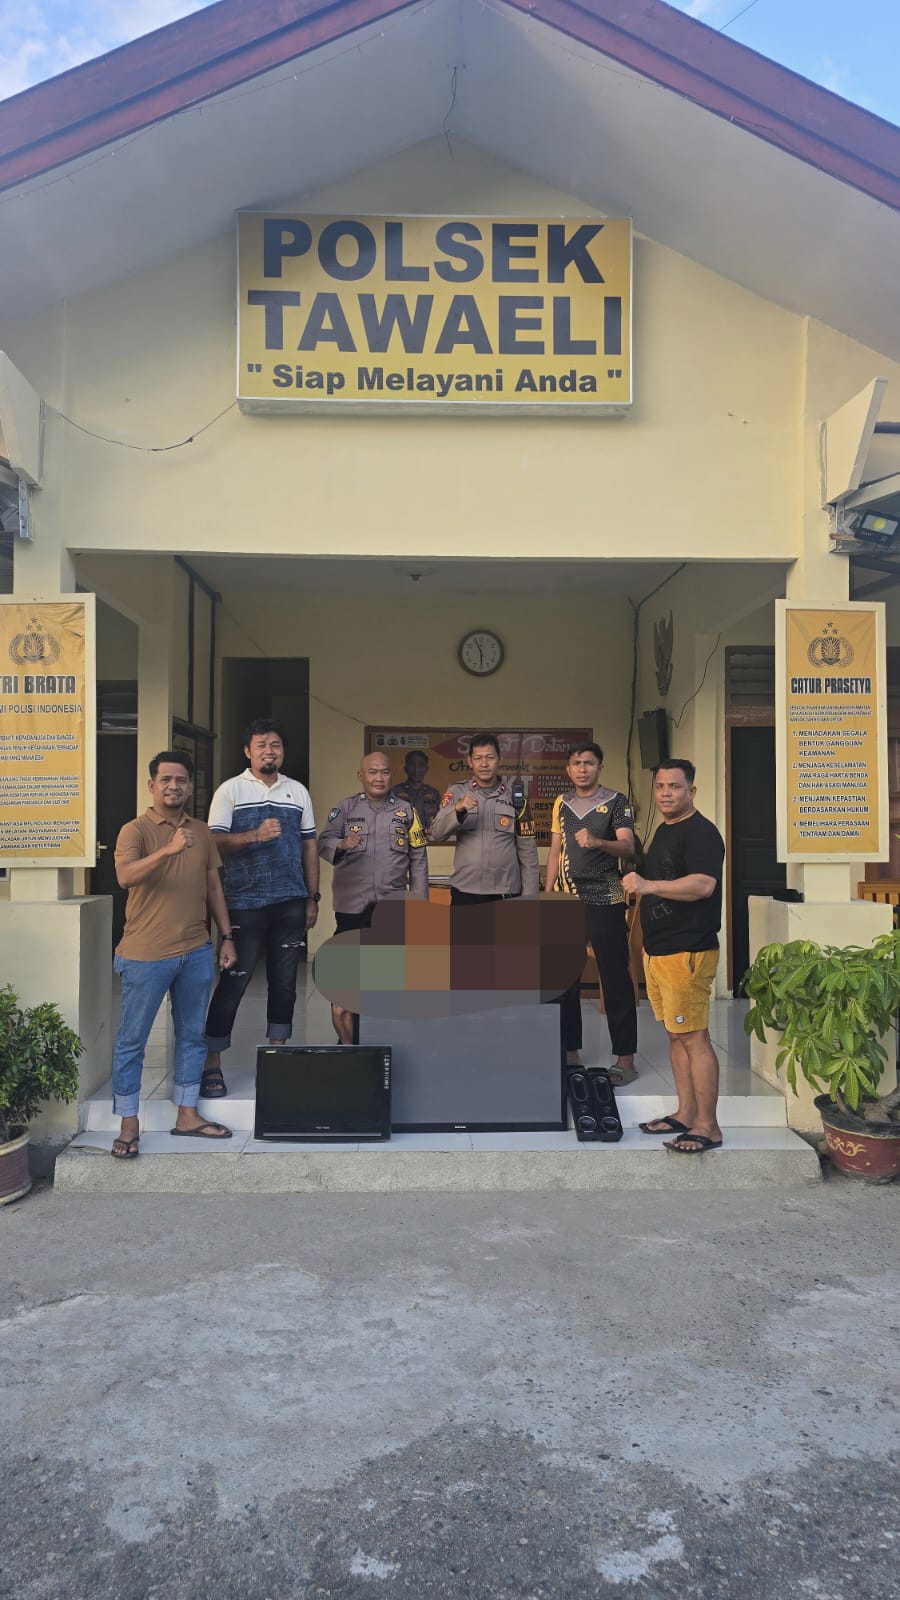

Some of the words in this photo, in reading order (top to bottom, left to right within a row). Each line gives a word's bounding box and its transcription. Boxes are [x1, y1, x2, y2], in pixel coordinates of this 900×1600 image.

[263, 218, 605, 284] POLSEK
[247, 289, 622, 356] TAWAELI
[272, 363, 345, 395] Siap
[357, 367, 503, 397] Melayani
[515, 369, 597, 393] Anda
[0, 675, 19, 694] RI
[24, 675, 76, 694] BRATA
[791, 677, 821, 694] CATUR
[825, 677, 871, 694] PRASETYA
[8, 704, 36, 714] POLISI
[37, 704, 83, 713] INDONESIA
